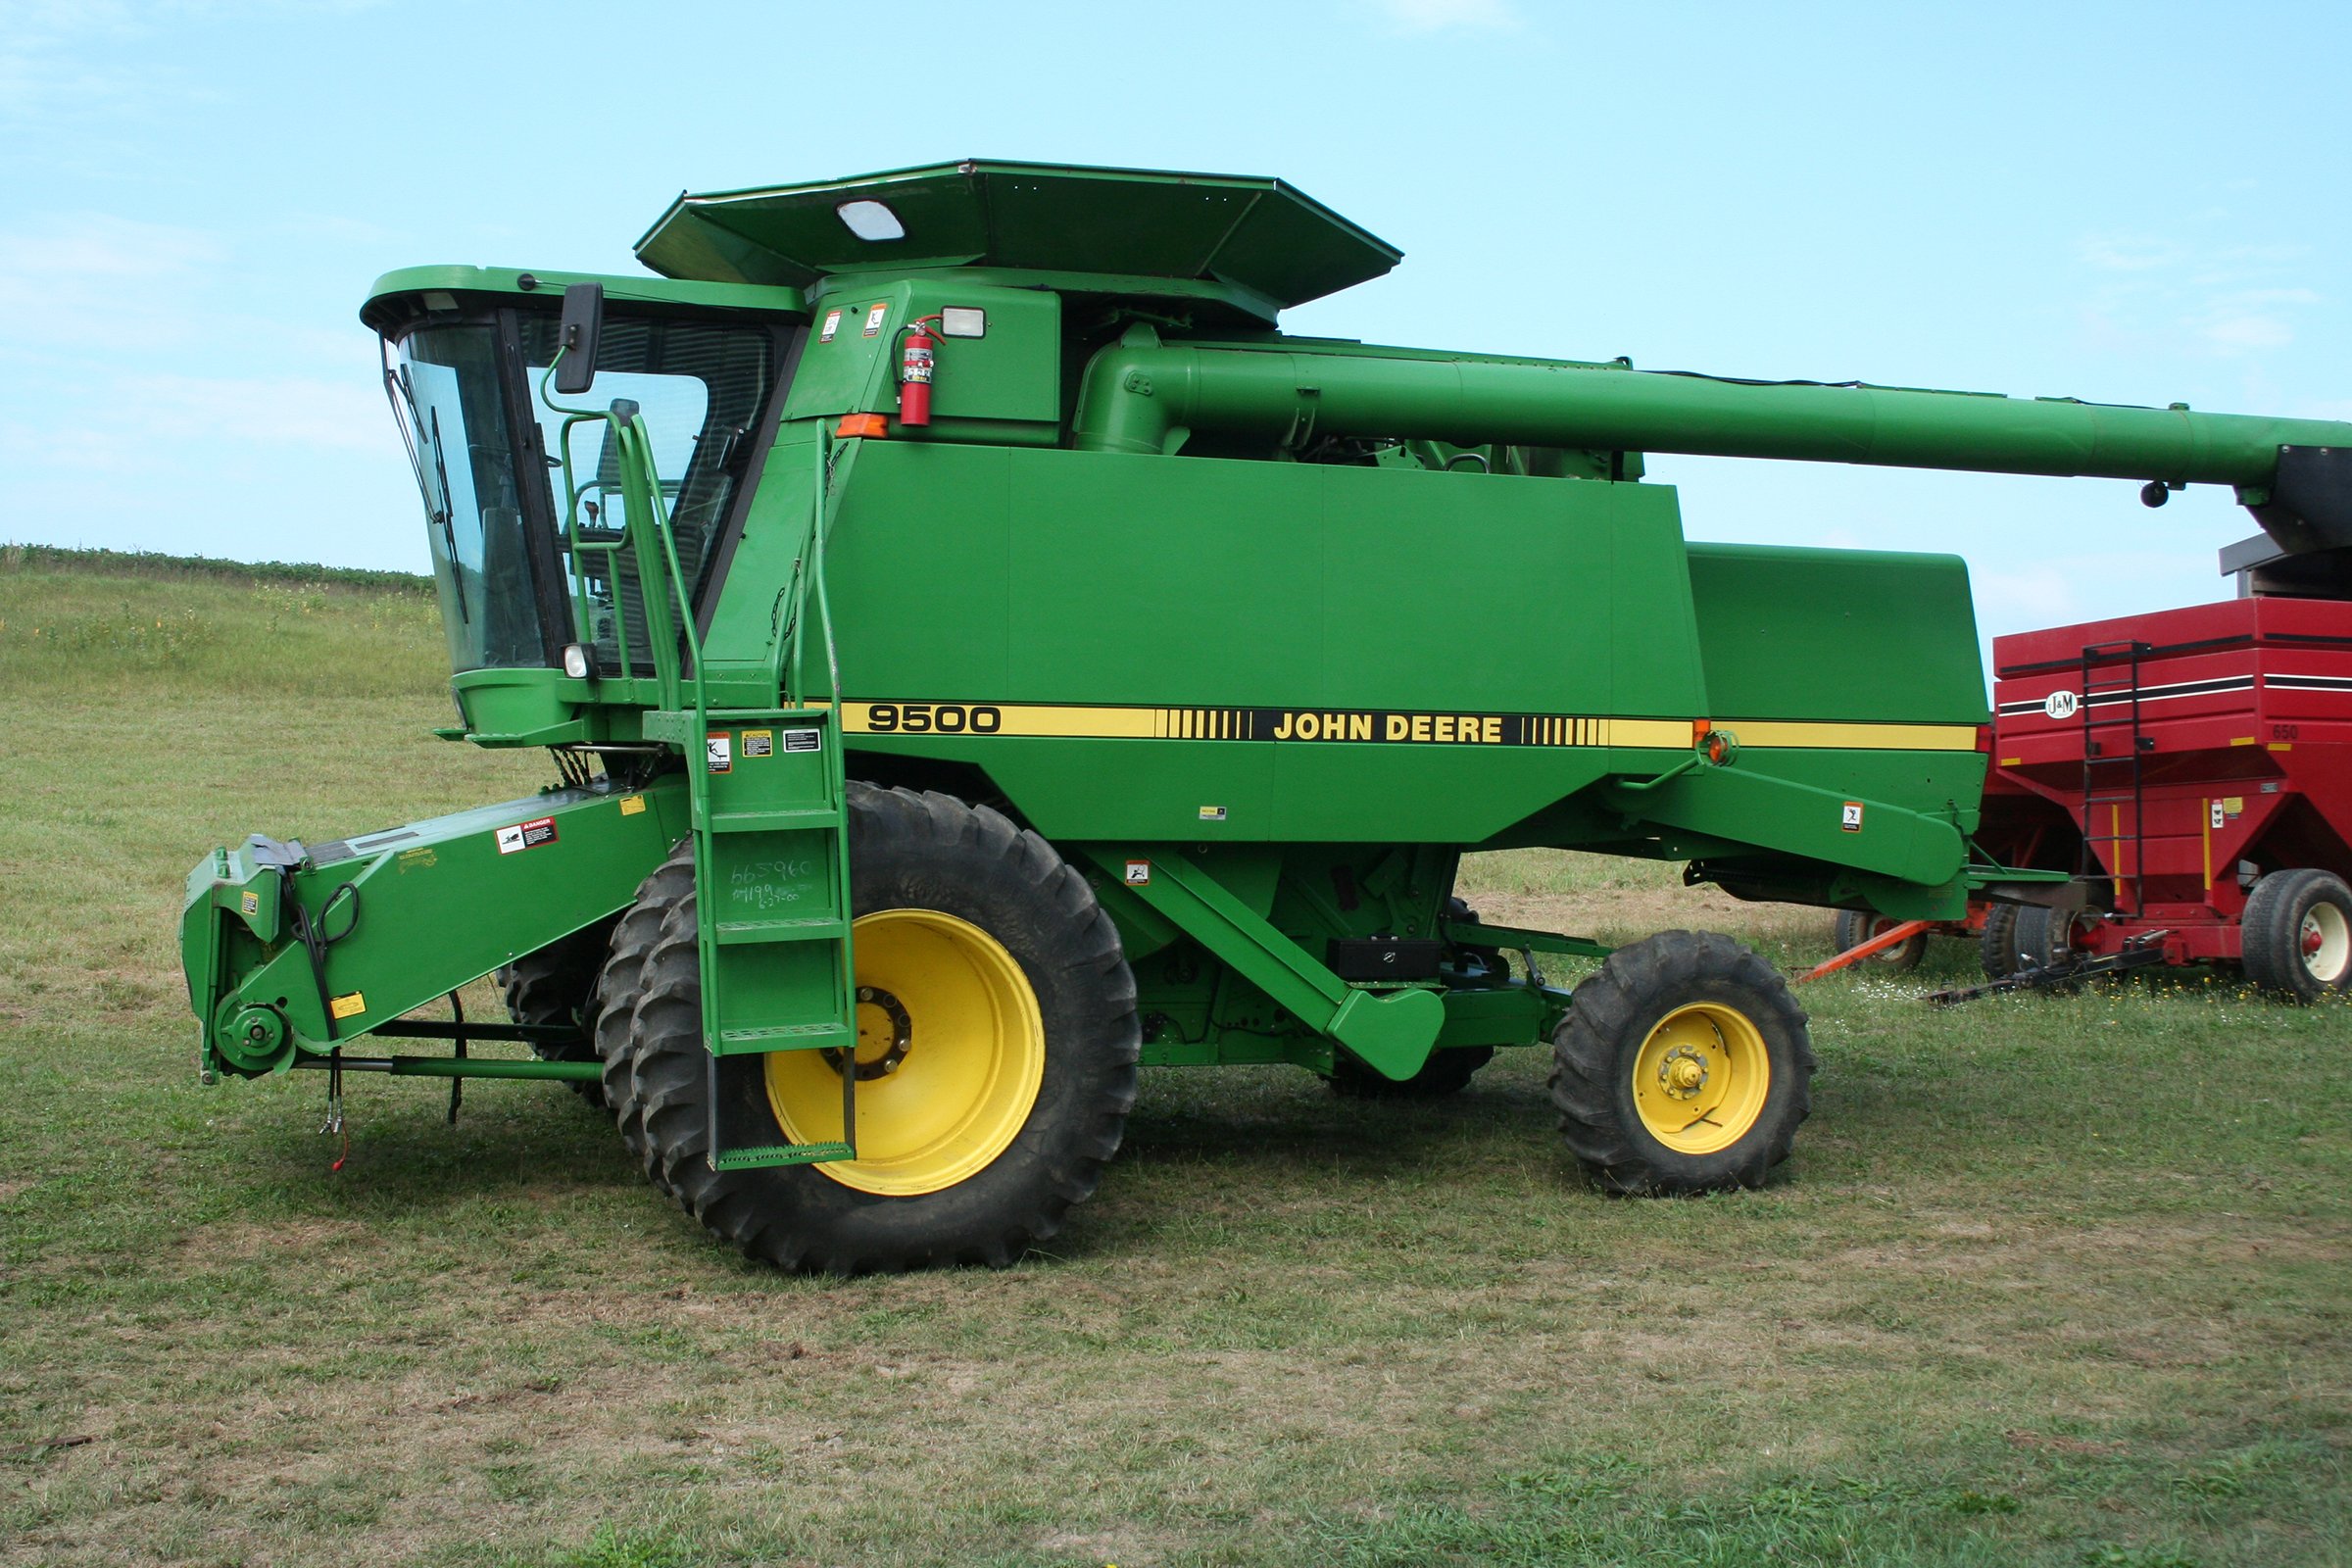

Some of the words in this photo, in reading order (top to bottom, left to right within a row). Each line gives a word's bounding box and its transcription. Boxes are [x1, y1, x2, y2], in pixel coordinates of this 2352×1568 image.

[2047, 694, 2074, 714] J&M
[868, 705, 1002, 733] 9500
[1274, 712, 1372, 740] JOHN
[1386, 714, 1502, 743] DEERE
[2274, 724, 2298, 739] 650
[529, 818, 551, 828] DANGER
